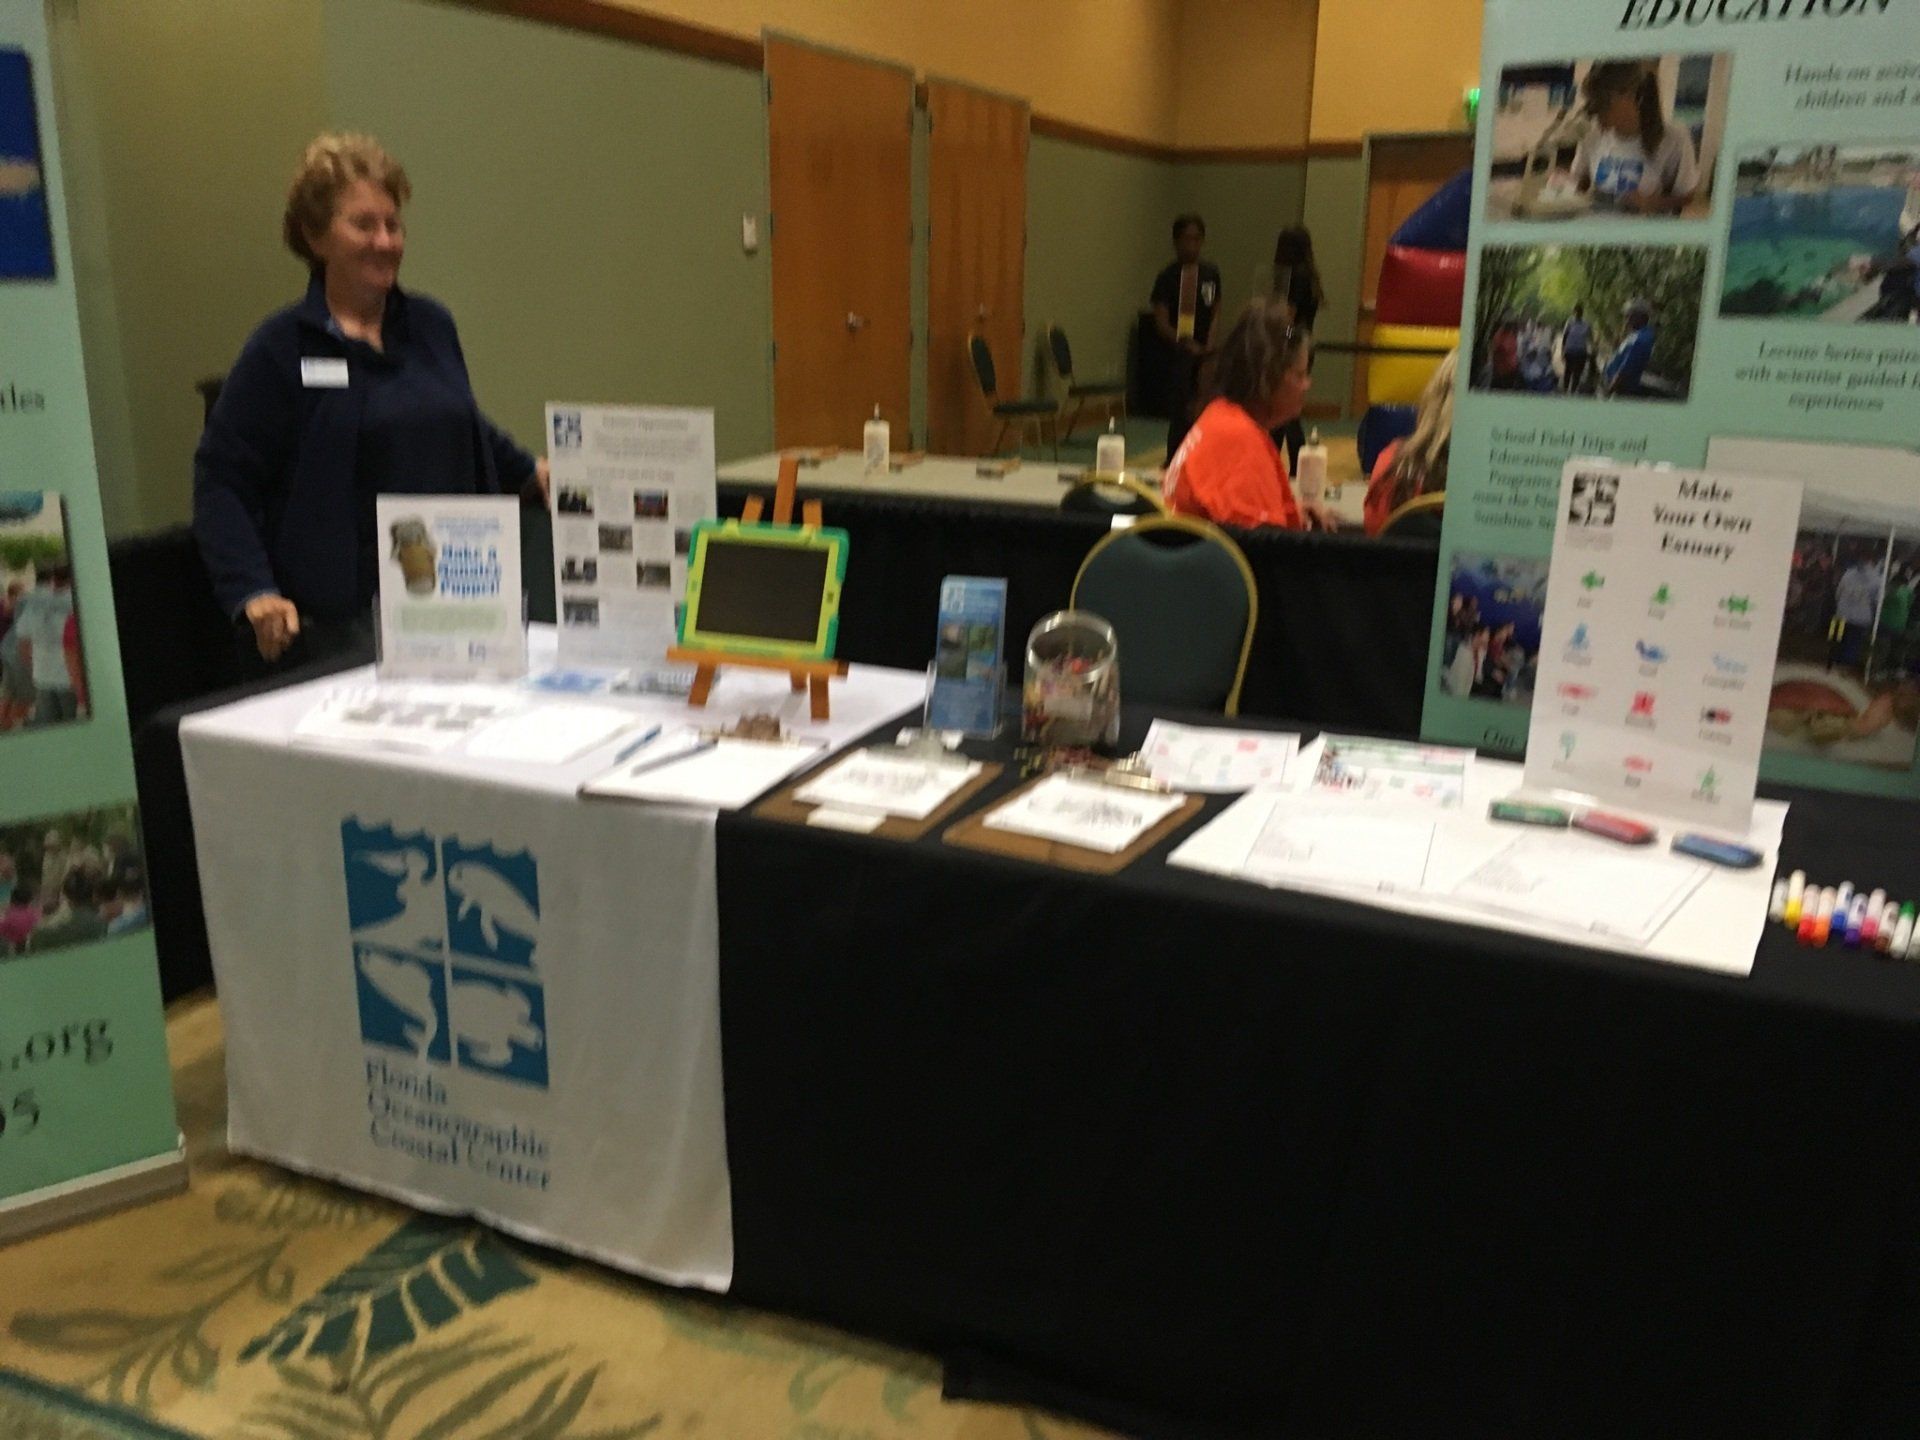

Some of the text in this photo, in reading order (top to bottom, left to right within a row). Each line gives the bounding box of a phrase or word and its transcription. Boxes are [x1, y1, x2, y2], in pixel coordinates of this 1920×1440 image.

[1678, 478, 1733, 502] Make
[1653, 503, 1752, 534] Your Own
[1660, 532, 1735, 564] Estuary
[365, 1054, 448, 1105] Florida
[366, 1084, 549, 1159] Oceanographic
[369, 1117, 459, 1166] Coastal
[467, 1140, 550, 1192] Center
